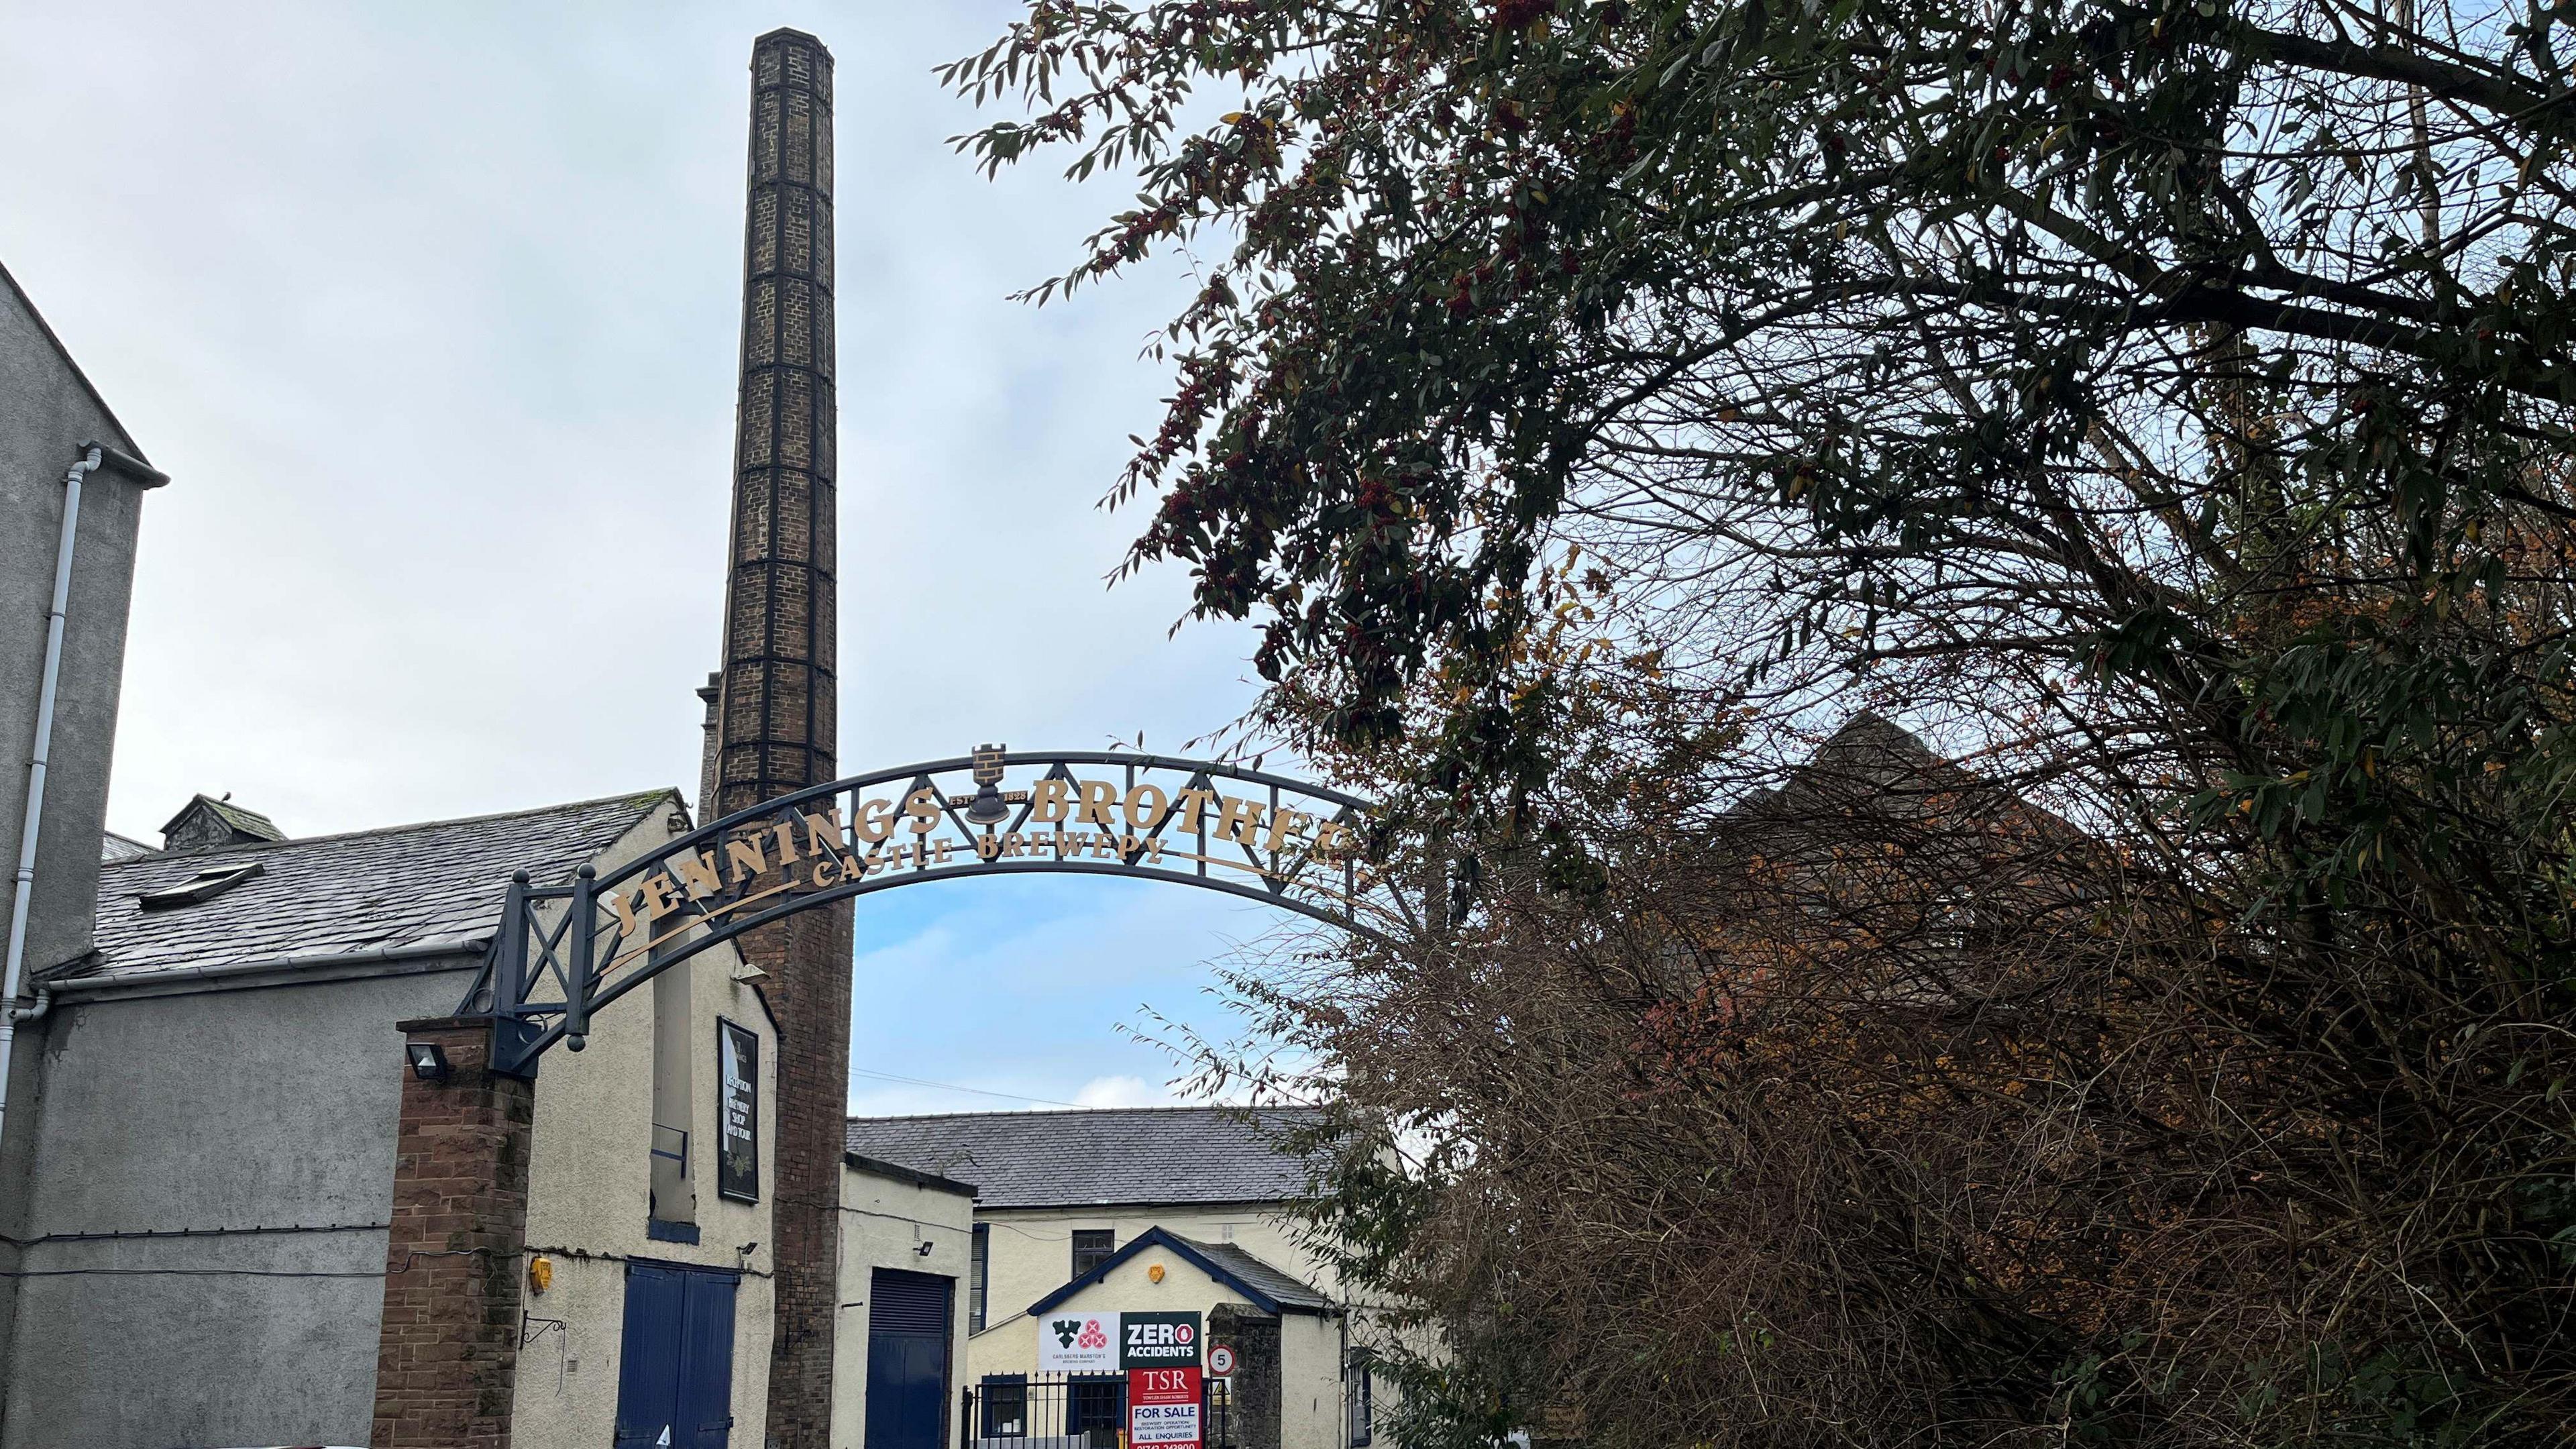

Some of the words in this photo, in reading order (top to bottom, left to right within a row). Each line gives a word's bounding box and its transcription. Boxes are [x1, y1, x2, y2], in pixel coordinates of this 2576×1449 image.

[1004, 791, 1026, 802] 1828
[611, 787, 941, 937] JENNINGS
[812, 837, 952, 888] CASTLE
[726, 1074, 751, 1093] RECEPTION
[732, 1112, 746, 1126] SHOP
[727, 1124, 738, 1136] AND
[737, 1127, 751, 1141] TOUR
[1128, 1324, 1194, 1344] ZERO
[1128, 1346, 1194, 1357] ACCIDENTS
[1218, 1354, 1226, 1365] 5
[1143, 1370, 1188, 1391] TSR
[1135, 1408, 1160, 1419] FOR
[1164, 1407, 1195, 1417] SALE
